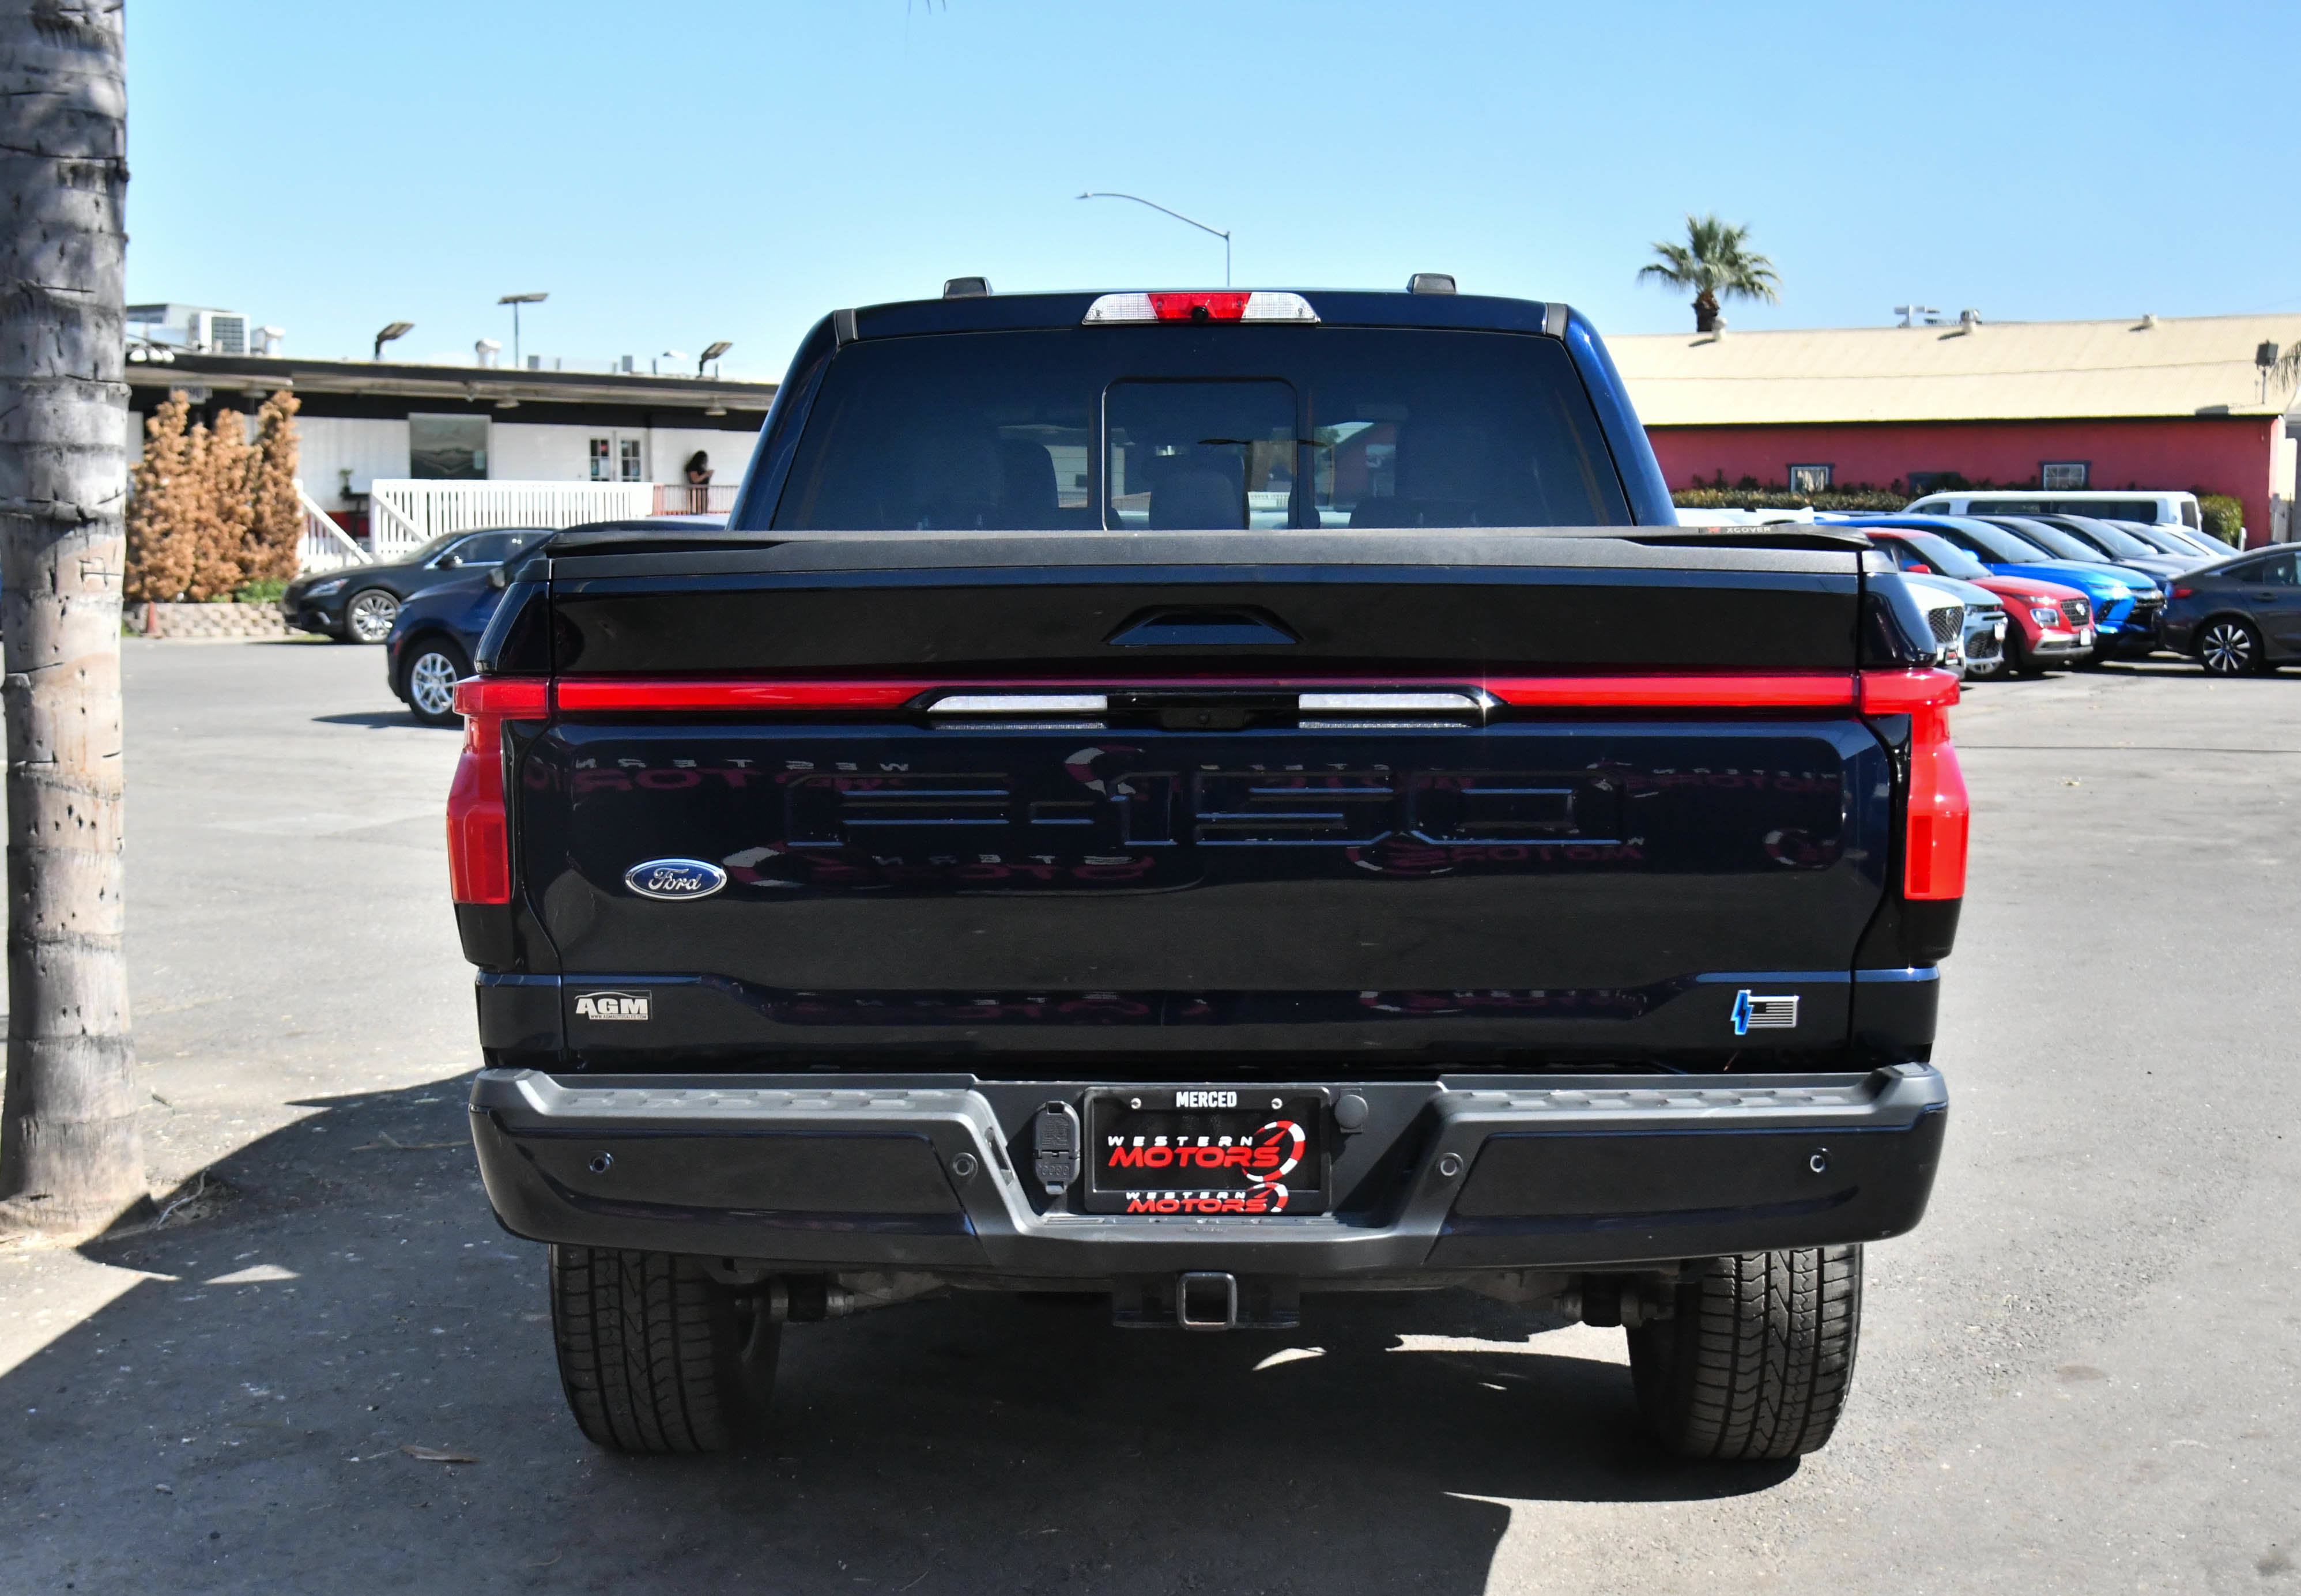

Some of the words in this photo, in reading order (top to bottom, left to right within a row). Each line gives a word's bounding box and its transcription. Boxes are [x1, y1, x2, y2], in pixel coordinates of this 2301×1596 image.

[648, 867, 702, 891] Ford
[575, 998, 648, 1014] AGM
[1176, 1091, 1238, 1108] MERCED
[1108, 1135, 1254, 1146] WESTERN
[1108, 1146, 1280, 1168] MOTORS
[1126, 1191, 1247, 1199] WESTERN
[1126, 1198, 1268, 1213] MOTORS
